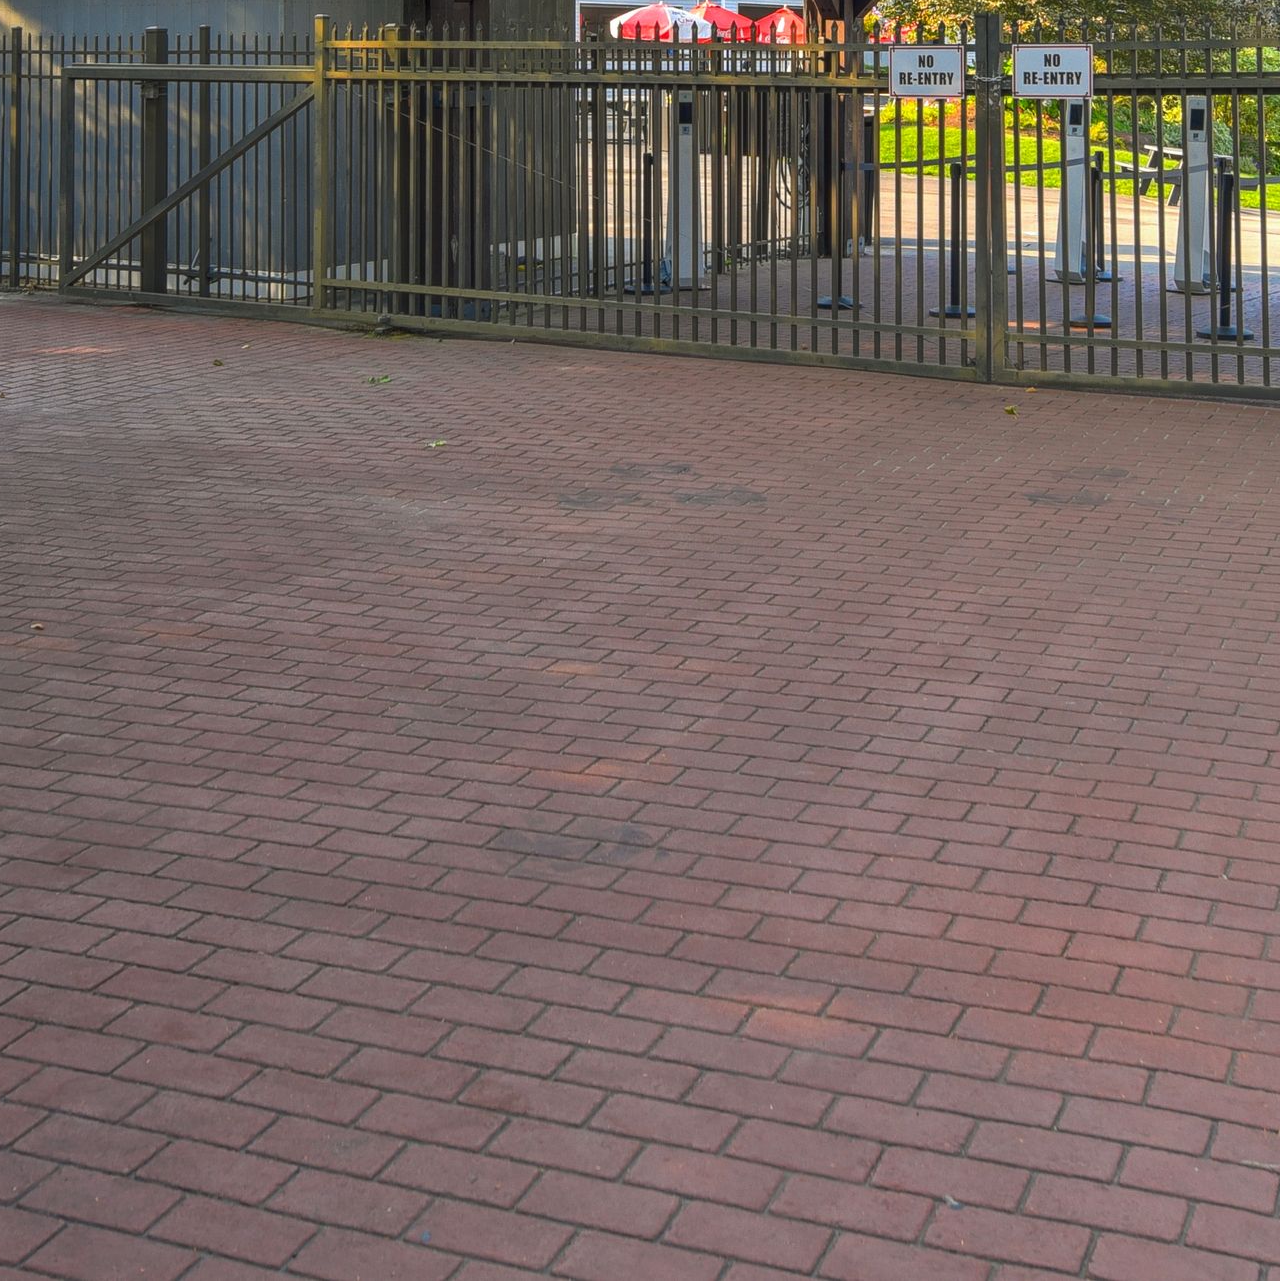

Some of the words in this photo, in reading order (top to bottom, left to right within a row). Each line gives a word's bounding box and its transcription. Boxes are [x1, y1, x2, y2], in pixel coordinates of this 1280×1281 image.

[918, 55, 934, 68] NO
[1044, 53, 1061, 67] NO
[899, 71, 954, 85] RE-ENTRY
[1023, 71, 1082, 85] RE-ENTRY
